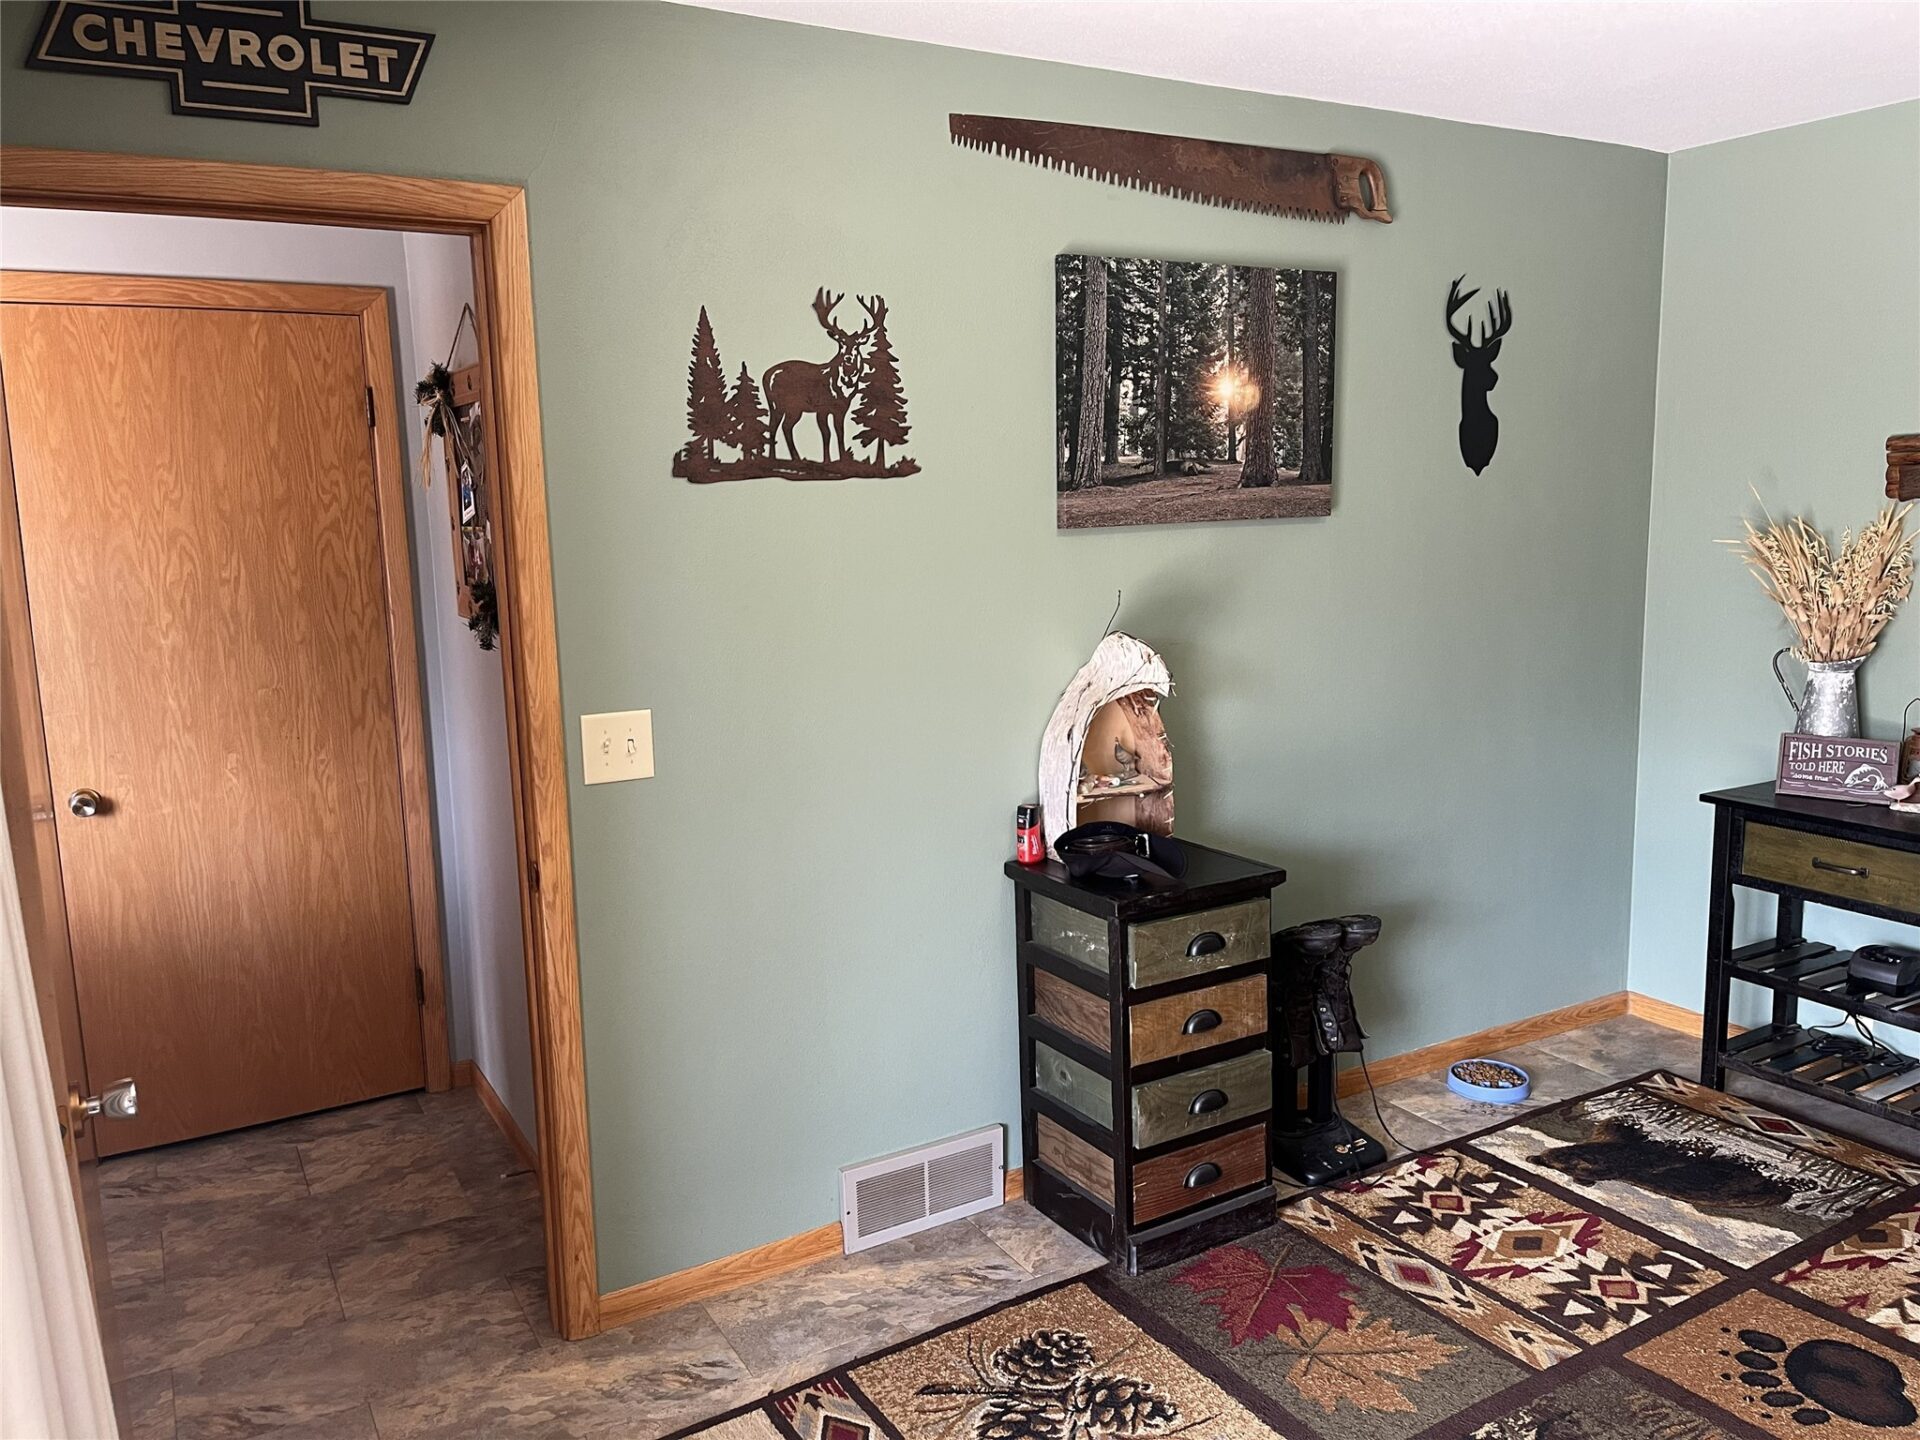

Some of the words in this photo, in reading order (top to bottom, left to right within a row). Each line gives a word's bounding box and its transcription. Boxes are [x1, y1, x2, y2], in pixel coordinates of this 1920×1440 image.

[72, 13, 399, 84] CHEVROLET
[1788, 741, 1823, 761] FISH
[1826, 744, 1888, 764] STORIES
[1789, 761, 1816, 772] TOLD
[1818, 760, 1846, 775] HERE
